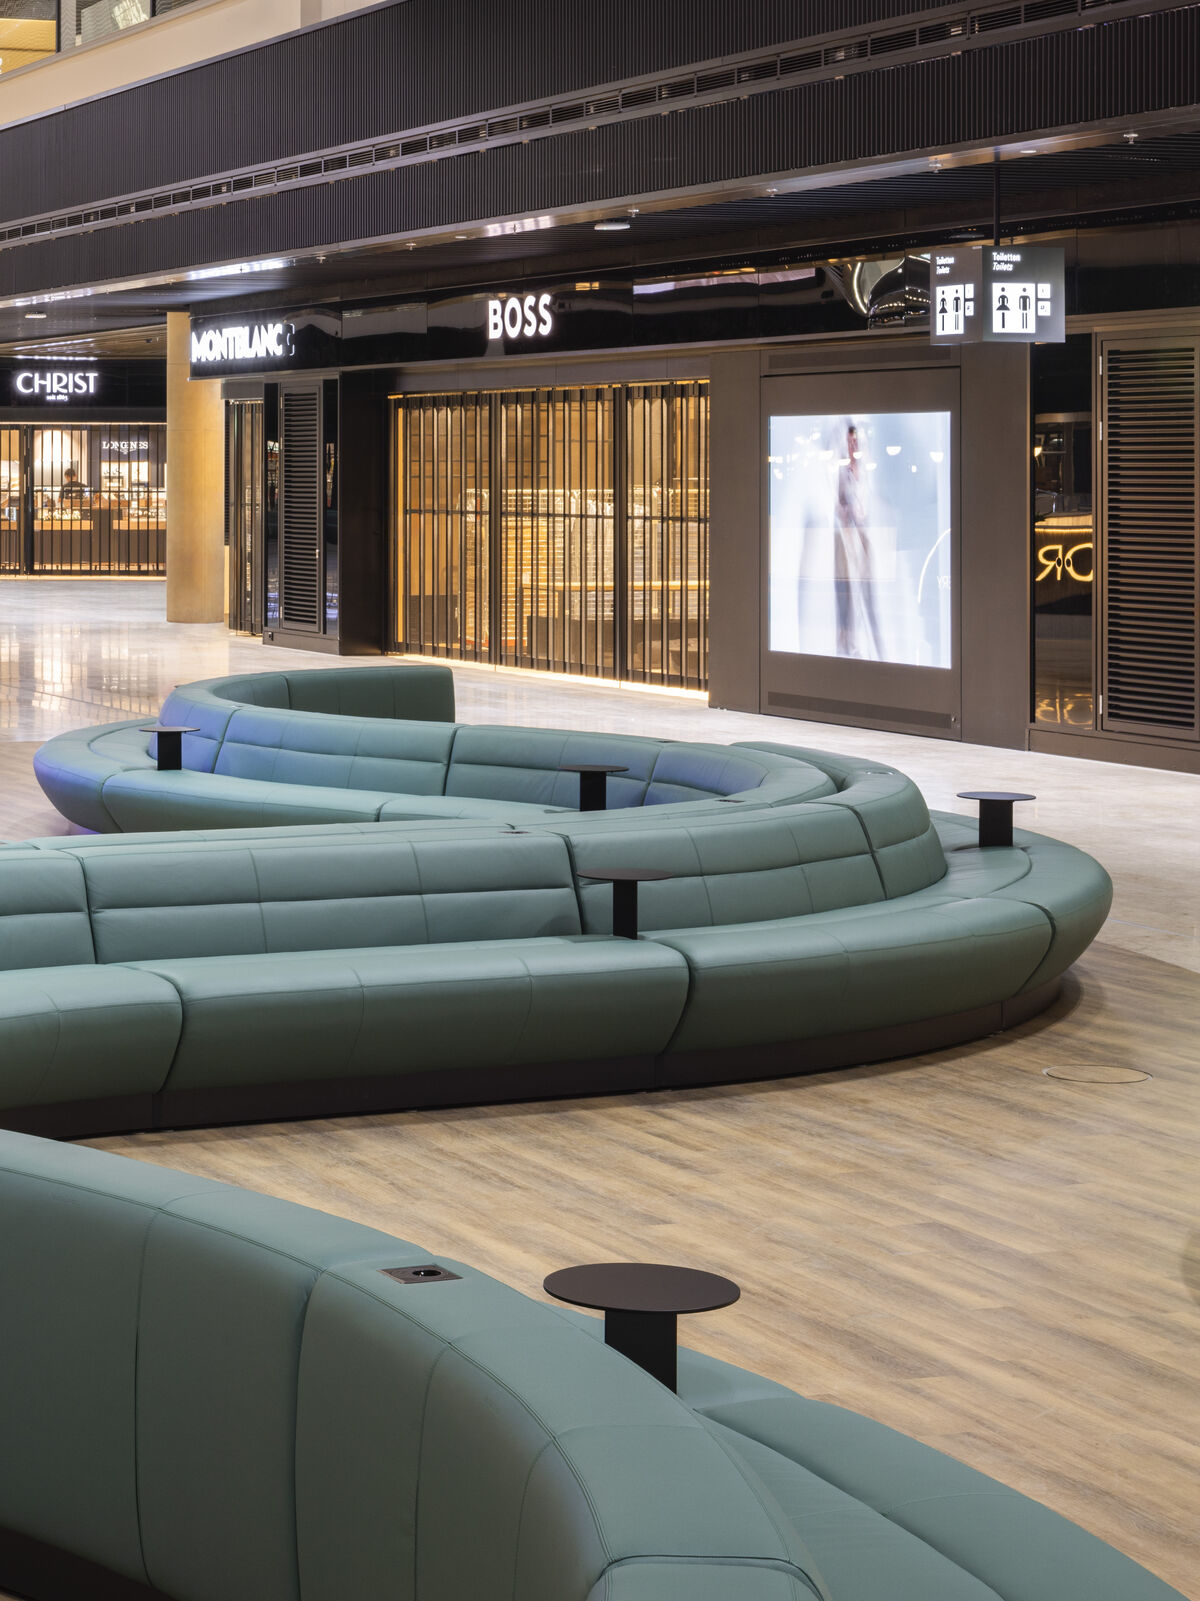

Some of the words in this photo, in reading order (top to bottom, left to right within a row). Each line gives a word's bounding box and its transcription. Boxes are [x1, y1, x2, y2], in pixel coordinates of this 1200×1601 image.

[936, 256, 954, 265] Toiletten
[992, 252, 1021, 262] Toiletten
[992, 262, 1013, 271] Toilets
[488, 294, 552, 340] BOSS
[191, 324, 283, 362] MONTBLANC
[16, 372, 98, 394] CHRIST
[102, 441, 149, 450] LONGINES
